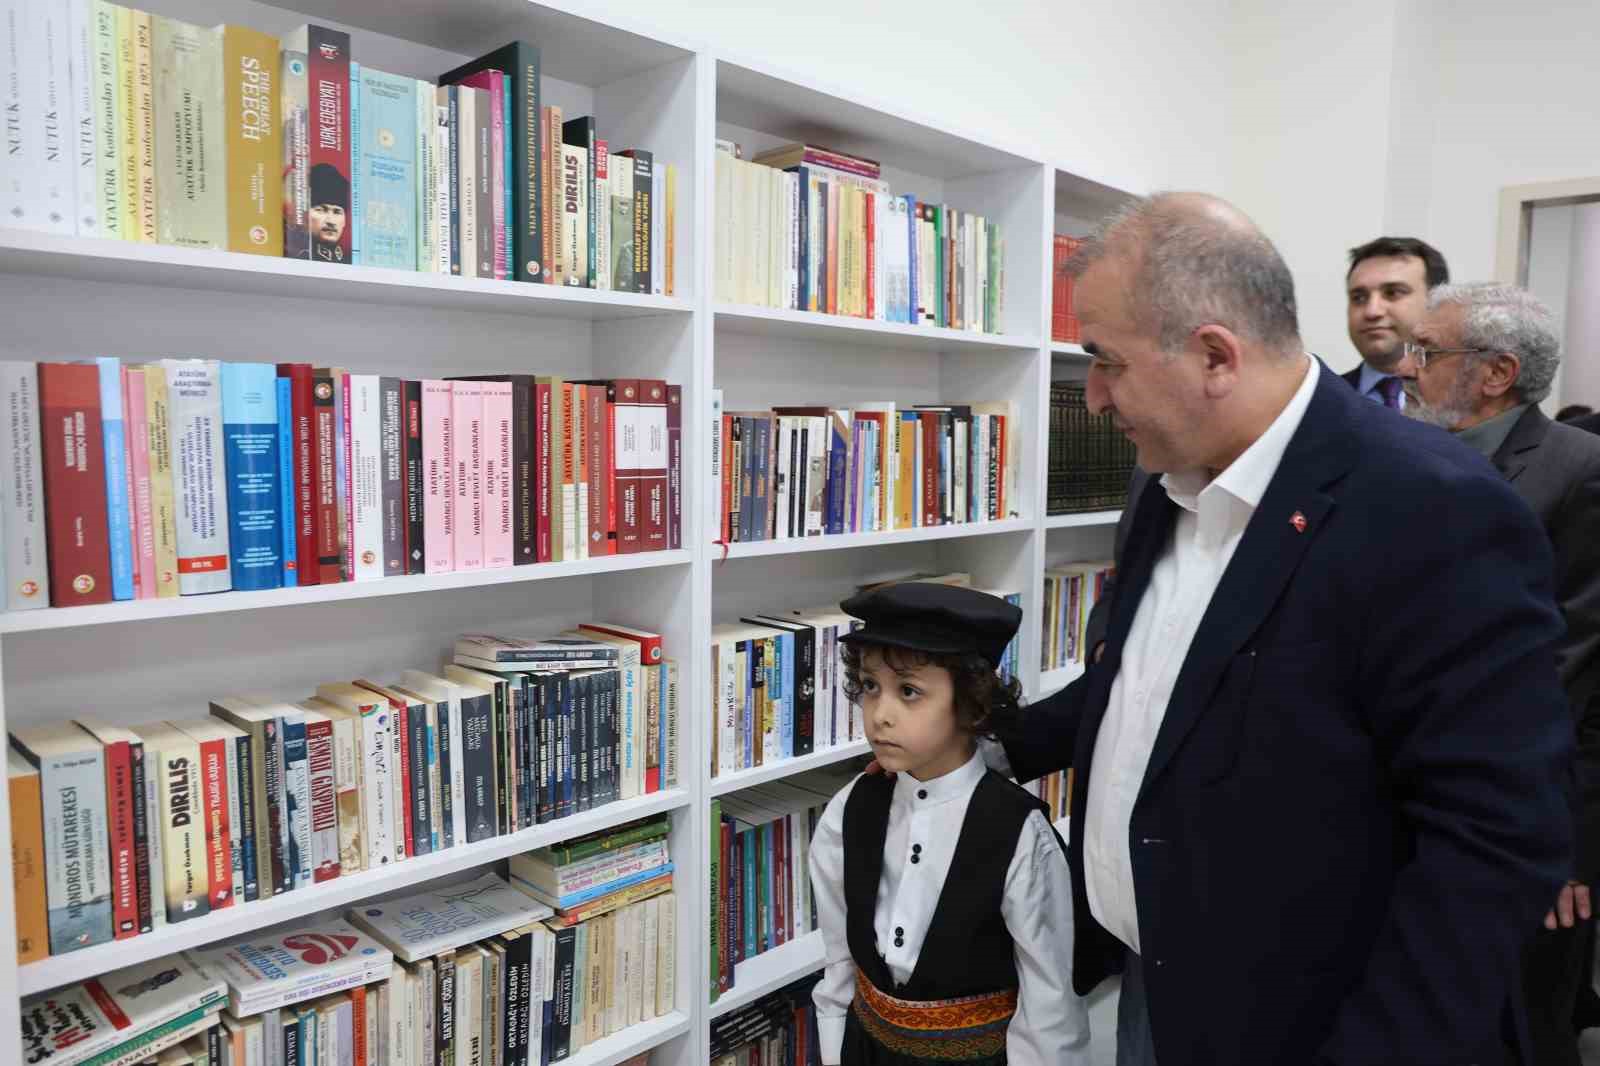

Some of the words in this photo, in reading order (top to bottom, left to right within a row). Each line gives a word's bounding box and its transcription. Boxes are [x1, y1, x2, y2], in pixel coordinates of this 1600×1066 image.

[241, 56, 260, 140] SPEECH
[261, 70, 271, 93] THE
[8, 103, 23, 155] NUTUK
[45, 111, 60, 162] NUTUK
[80, 117, 94, 167] NUTUK
[100, 83, 115, 159] Konferansları
[139, 93, 153, 168] Konferansları
[261, 96, 271, 136] GREAT
[103, 169, 117, 232] ATATÜRK
[126, 155, 137, 217] ATATÜRK
[141, 176, 154, 240] ATATÜRK
[564, 442, 572, 480] ATATÜRK
[472, 716, 481, 750] MECMUA
[58, 786, 80, 859] MÜTAREKESİ
[311, 776, 336, 833] GASPIRALI
[64, 860, 82, 920] MONDROS
[185, 870, 194, 894] Turgut
